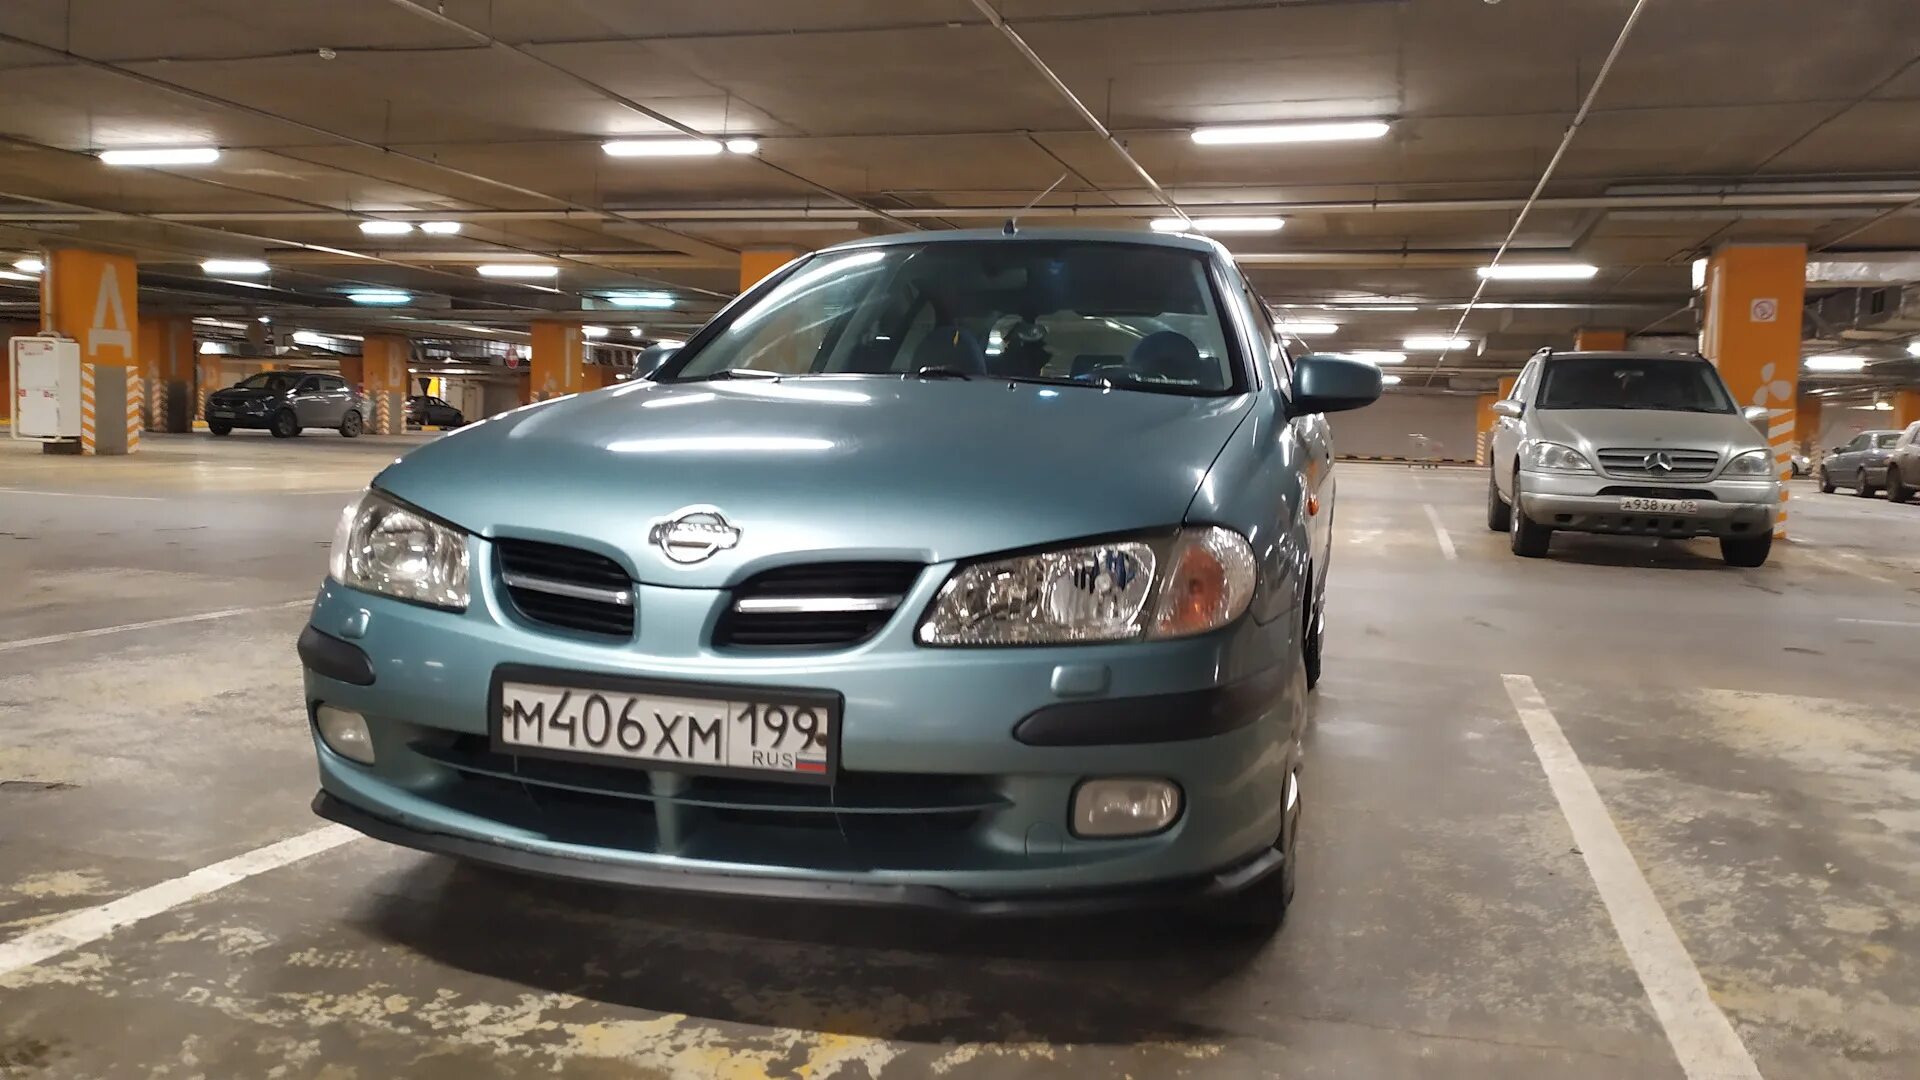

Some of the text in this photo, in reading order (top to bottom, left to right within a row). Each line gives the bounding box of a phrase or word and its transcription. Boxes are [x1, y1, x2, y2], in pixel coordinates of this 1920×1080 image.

[88, 264, 132, 358] Д
[513, 690, 819, 760] М406ХМ 199
[752, 750, 793, 769] RUS
